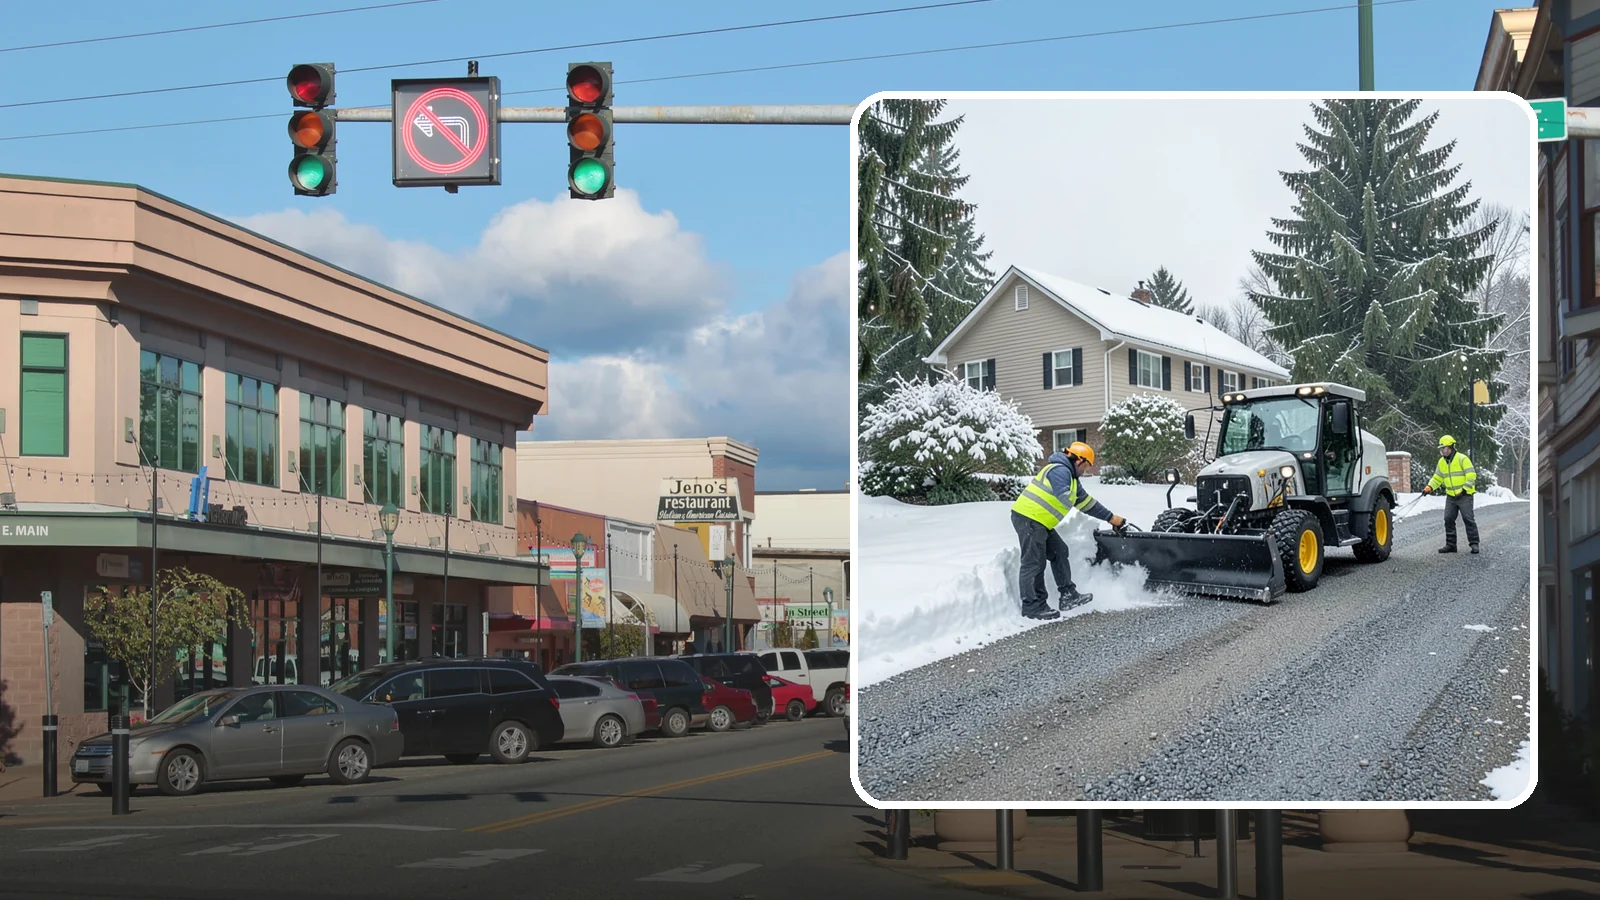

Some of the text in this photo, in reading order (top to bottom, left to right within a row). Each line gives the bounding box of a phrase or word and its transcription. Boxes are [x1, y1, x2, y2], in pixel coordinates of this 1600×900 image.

[669, 480, 727, 494] Jeno's
[665, 496, 731, 509] restaurant
[658, 509, 681, 519] Italian
[685, 509, 714, 519] American
[714, 509, 737, 519] Cuisine
[2, 525, 49, 536] E. MAIN
[797, 607, 828, 617] Street
[790, 619, 823, 627] lass
